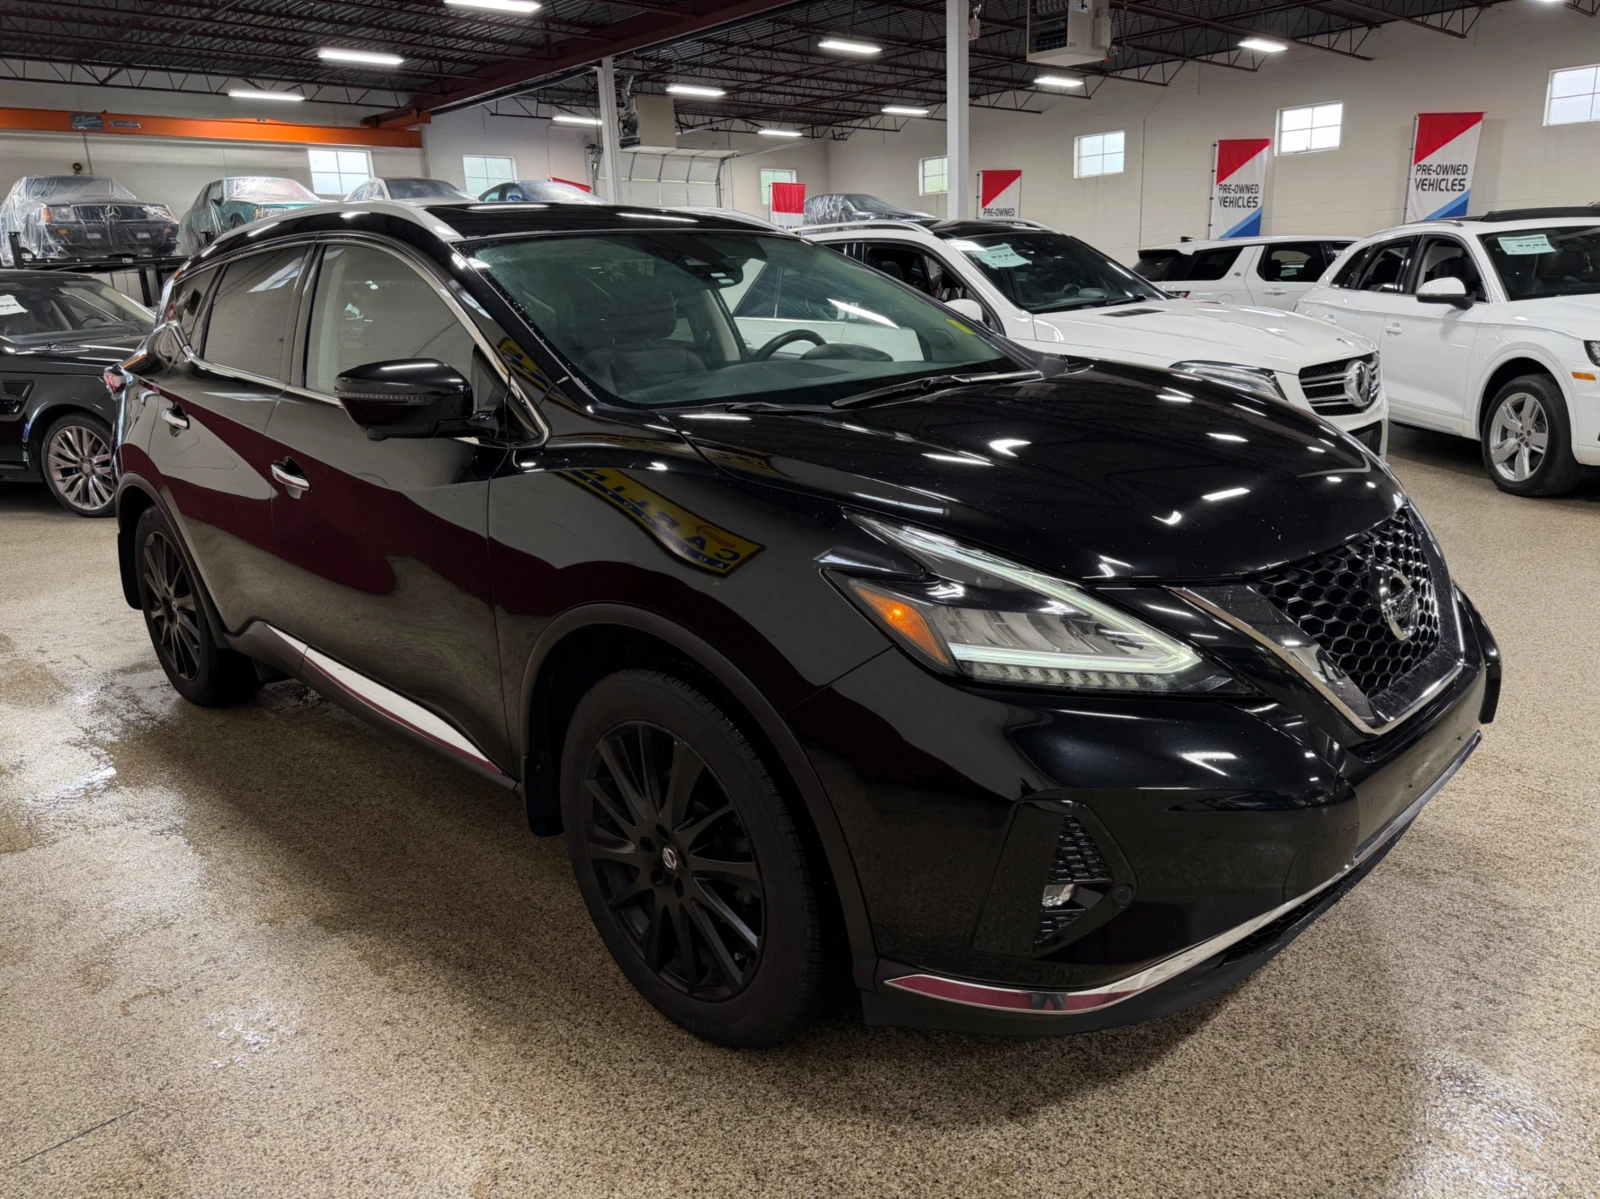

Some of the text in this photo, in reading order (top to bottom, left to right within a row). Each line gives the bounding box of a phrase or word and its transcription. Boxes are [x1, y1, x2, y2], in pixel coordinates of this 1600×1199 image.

[1416, 163, 1468, 176] PRE-OWNED
[1219, 183, 1259, 194] PRE-OWNED
[1415, 177, 1466, 192] VEHICLES
[1219, 196, 1258, 208] VEHICLES
[983, 207, 1015, 217] PRE-OWNED
